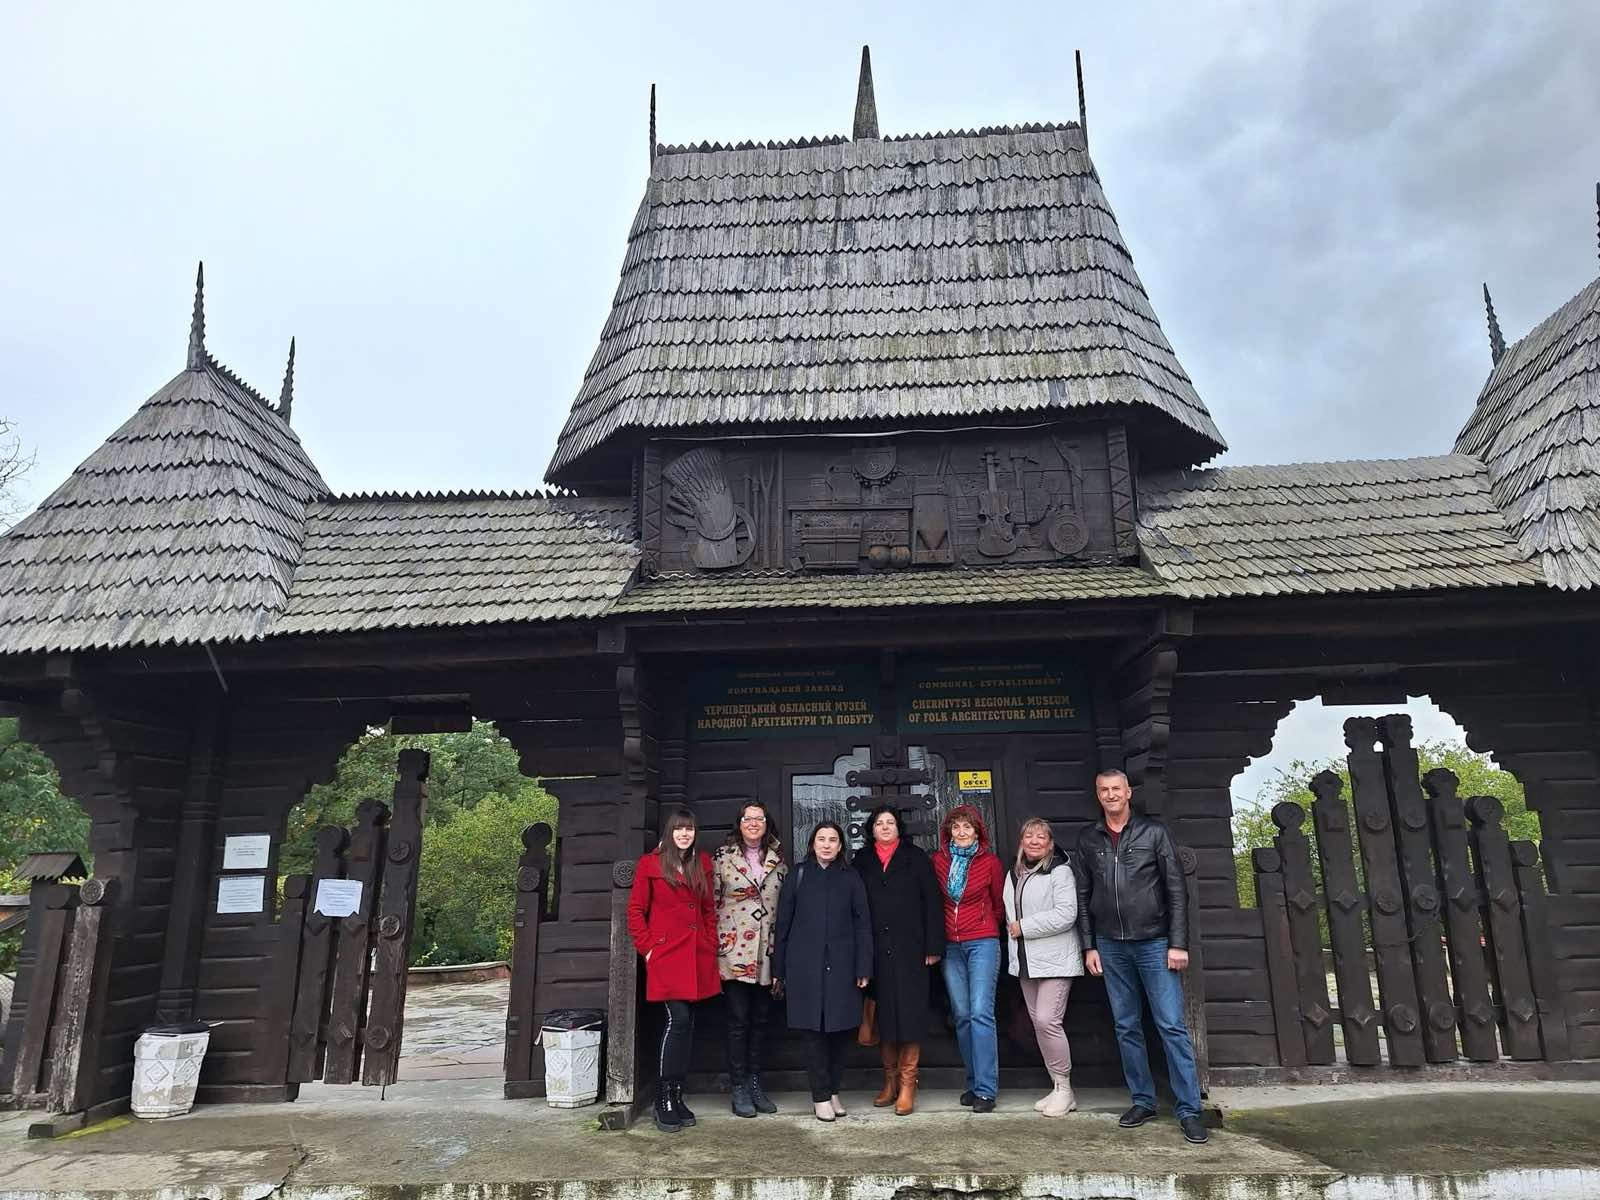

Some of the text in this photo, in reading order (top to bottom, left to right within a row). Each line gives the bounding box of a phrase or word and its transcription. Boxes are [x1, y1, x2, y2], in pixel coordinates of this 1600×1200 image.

[704, 698, 867, 715] ЧЕРНІВЕЦЬКИЙ ОБЛАСНИЙ МУЗЕЙ
[912, 695, 1070, 710] CHERNIVTSI REGIONAL MUSEUM
[697, 713, 874, 730] НАРОДНОЇ АРХІТЕКТУРИ ТА ПОБУТУ
[908, 708, 1076, 723] OF FOLK ARCHITECTURE AND LIFE
